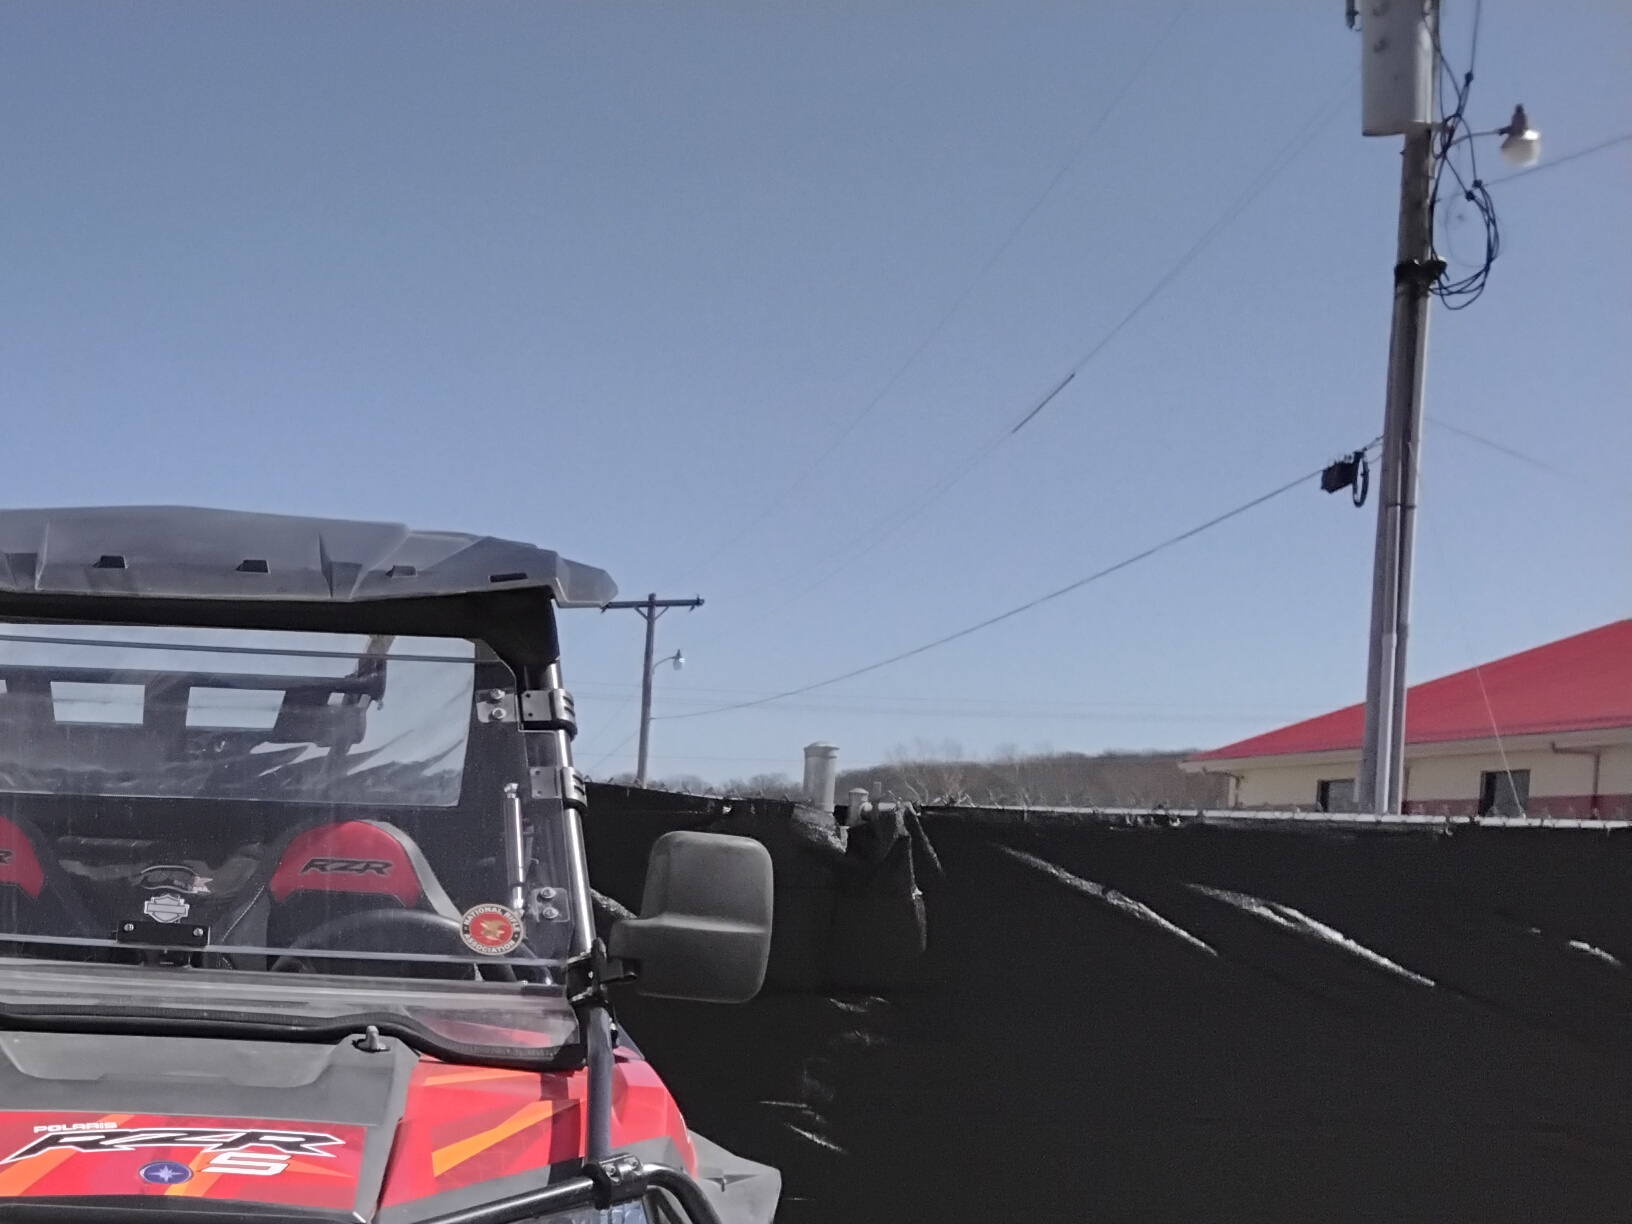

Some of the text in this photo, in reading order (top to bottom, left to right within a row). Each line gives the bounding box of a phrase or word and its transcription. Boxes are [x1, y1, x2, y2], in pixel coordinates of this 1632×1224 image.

[300, 857, 394, 877] RZR
[464, 907, 521, 932] NATIONAL RIFLE
[464, 933, 516, 953] ASSOCIATION
[33, 1122, 118, 1133] POLARIS
